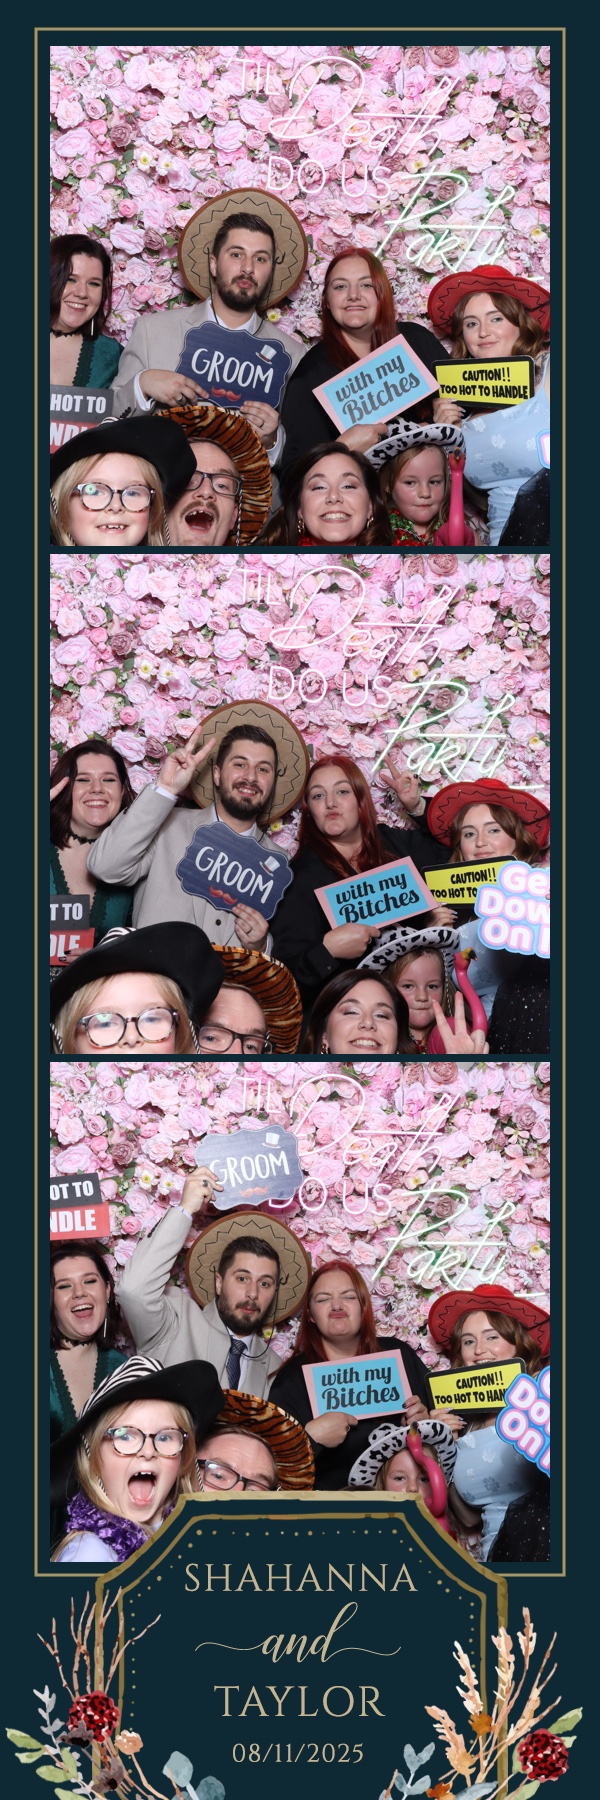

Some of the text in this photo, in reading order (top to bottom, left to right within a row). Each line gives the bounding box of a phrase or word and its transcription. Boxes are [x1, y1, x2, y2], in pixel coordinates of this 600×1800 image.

[269, 56, 460, 156] Death
[266, 156, 392, 199] DO US
[191, 348, 274, 394] GROOM
[335, 354, 406, 403] with my
[462, 367, 511, 382] CAUTION!!
[50, 393, 107, 414] HOT TO
[342, 372, 421, 424] Bitches
[440, 384, 529, 400] TOO HOT TO HANDLE
[269, 565, 460, 666] Death
[267, 666, 392, 709] DO US
[194, 846, 274, 904] GROOM
[335, 873, 408, 905] with my
[448, 887, 465, 898] HOT
[466, 886, 478, 898] TO
[450, 867, 497, 884] CAUTION!!
[62, 902, 83, 921] TO
[339, 888, 420, 924] Bitches
[483, 917, 532, 949] On
[290, 1073, 460, 1174] Death
[209, 1150, 290, 1188] GROOM
[71, 1180, 94, 1197] TO
[342, 1182, 392, 1217] US
[321, 1365, 392, 1387] with my
[456, 1370, 505, 1389] CAUTION!!
[321, 1384, 401, 1411] Bitches
[434, 1388, 508, 1404] TOO HOT TO HAN
[510, 1379, 550, 1434] Do
[501, 1410, 543, 1457] On
